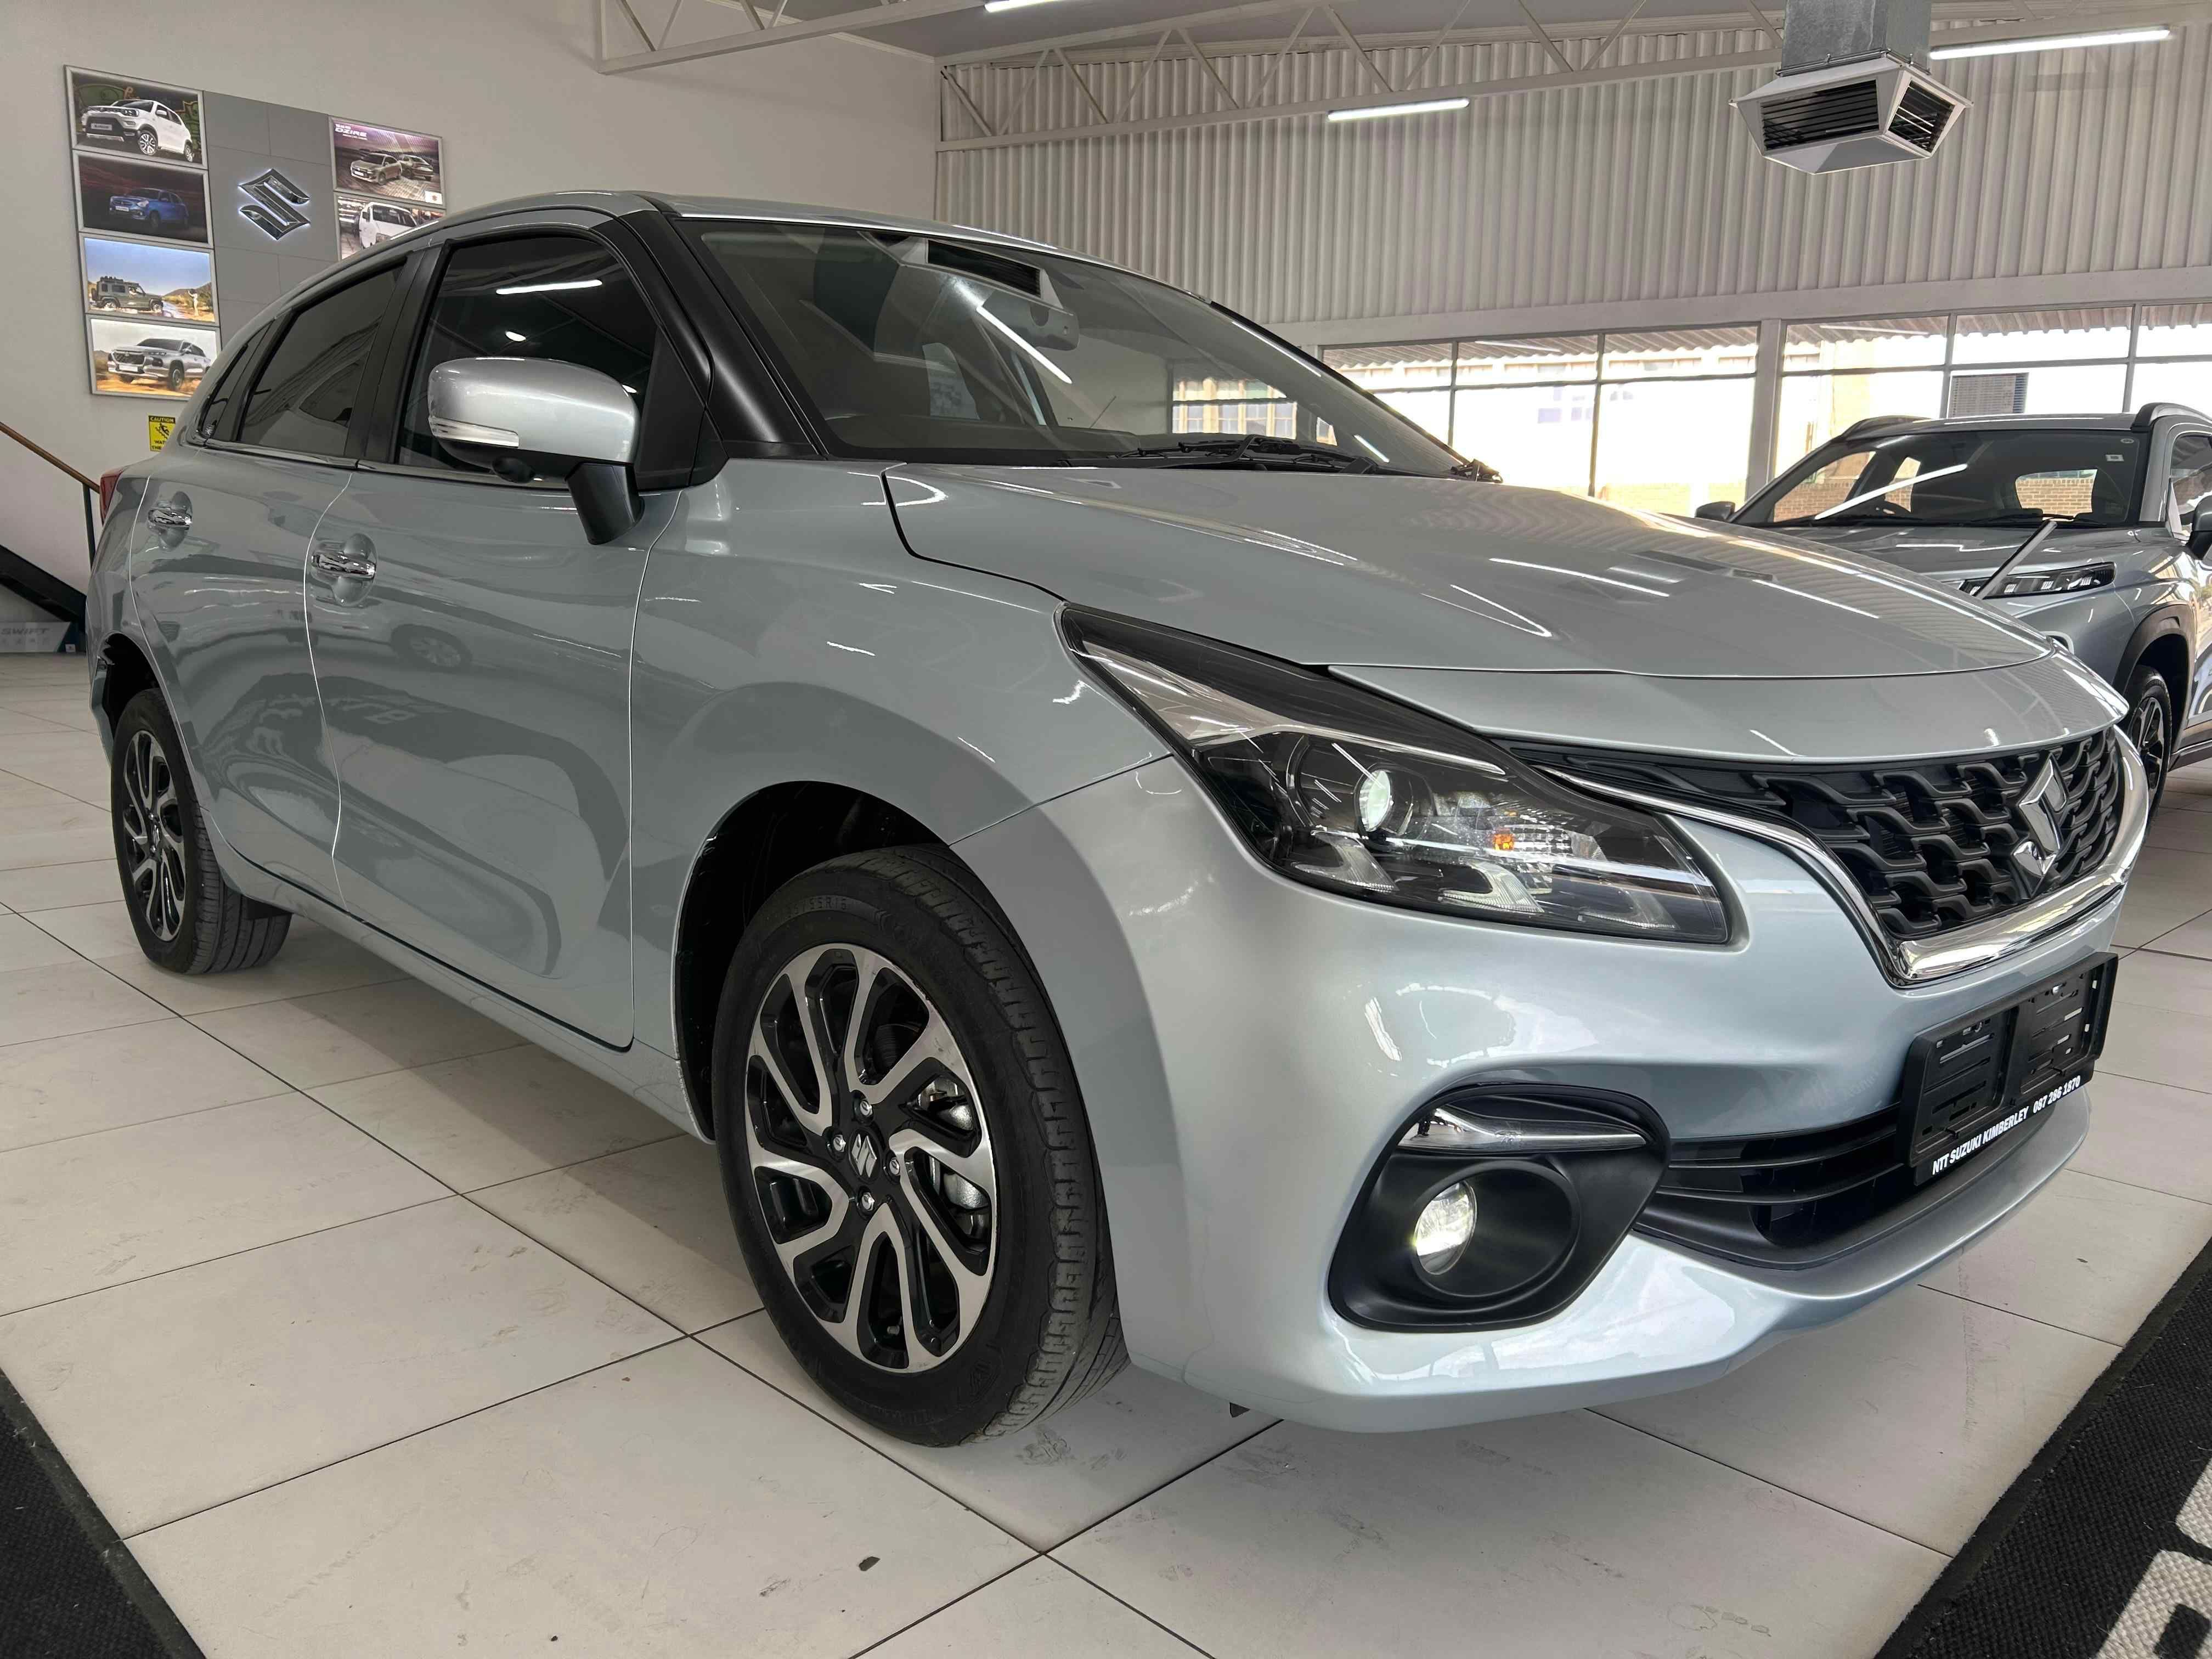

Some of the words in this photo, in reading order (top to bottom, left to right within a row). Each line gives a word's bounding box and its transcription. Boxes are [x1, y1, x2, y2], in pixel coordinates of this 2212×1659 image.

[335, 127, 367, 137] DZIRE
[1932, 1153, 1950, 1175] NTT
[1949, 1133, 1982, 1164] SUZUKI
[1982, 1106, 2030, 1144] KIMBERLEY
[2047, 1086, 2062, 1105] 286
[2062, 1075, 2081, 1096] 1870
